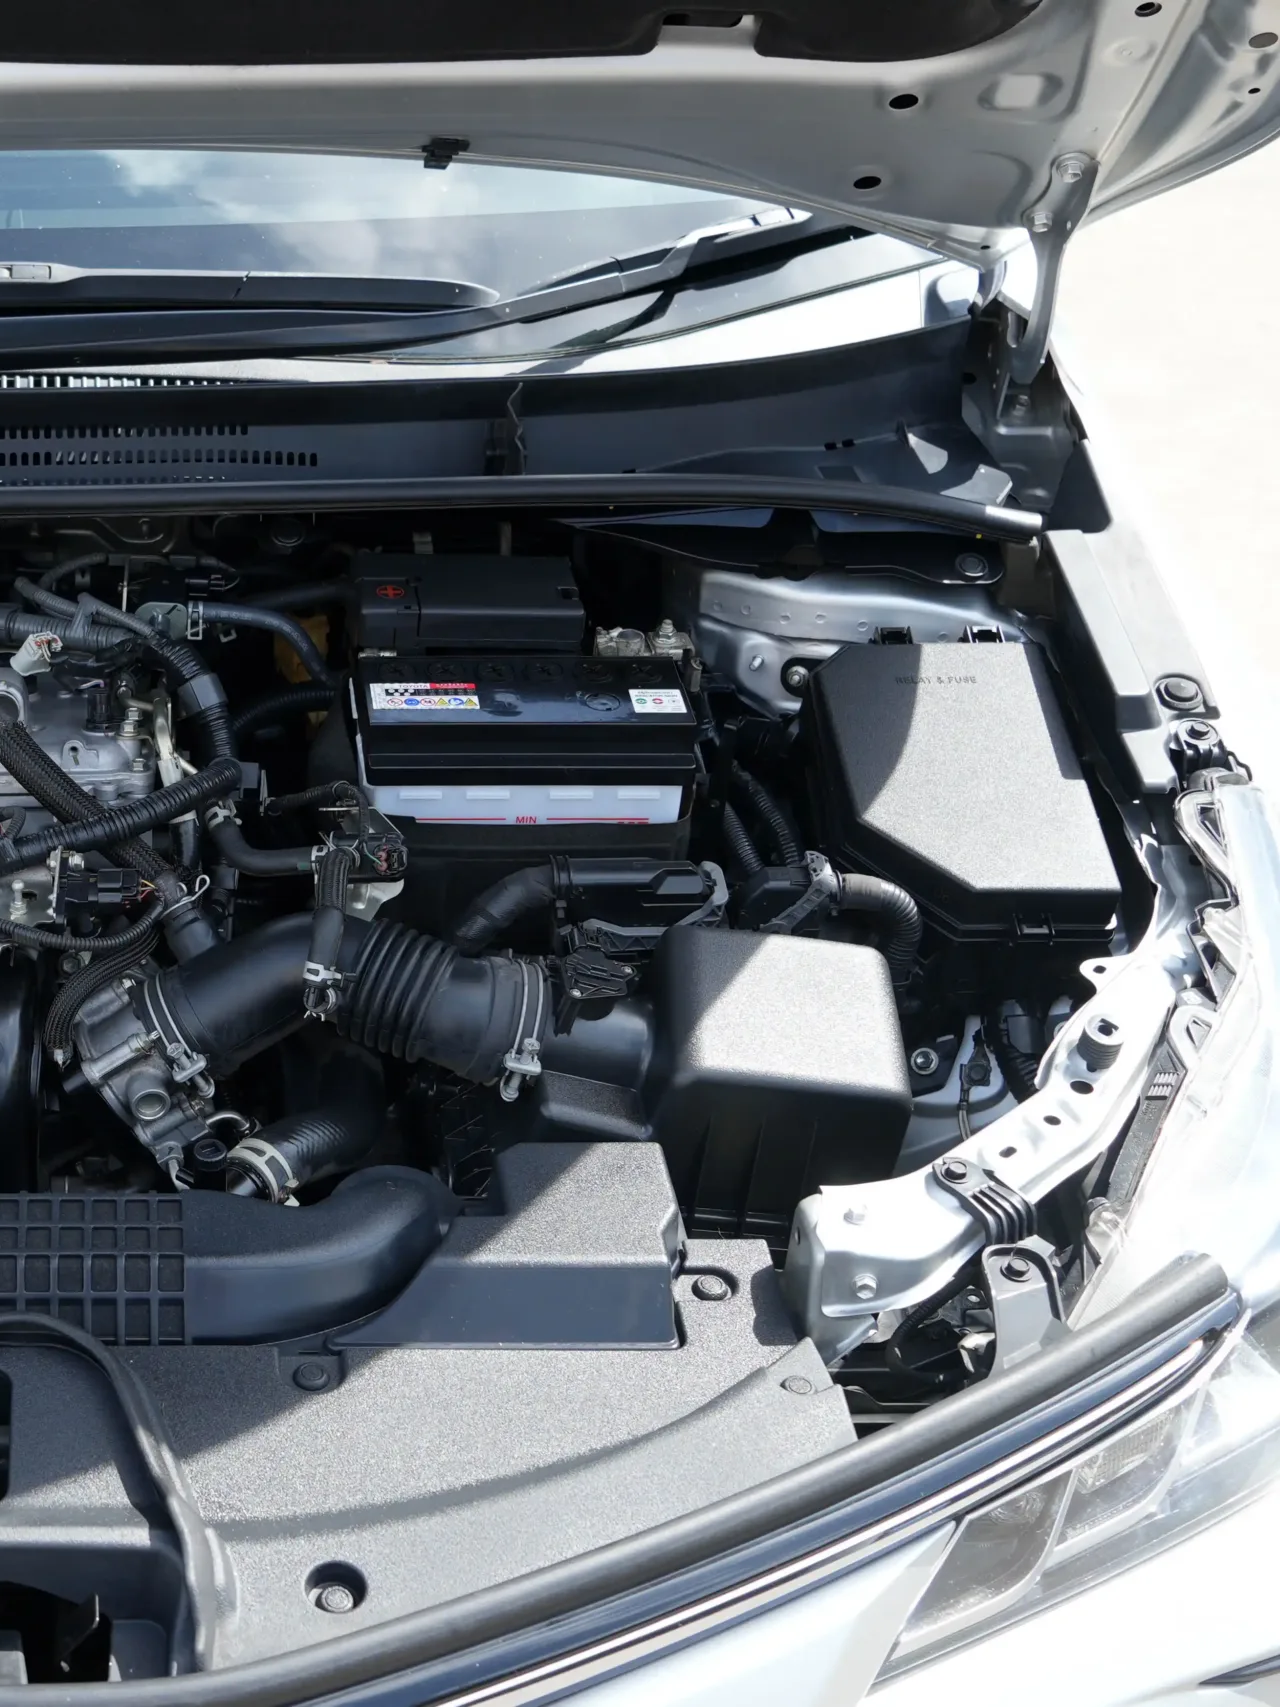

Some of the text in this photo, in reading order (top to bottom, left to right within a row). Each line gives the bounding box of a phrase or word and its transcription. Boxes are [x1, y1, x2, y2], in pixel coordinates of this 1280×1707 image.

[895, 676, 977, 684] RELAY & FUSE
[515, 816, 537, 824] MIN
